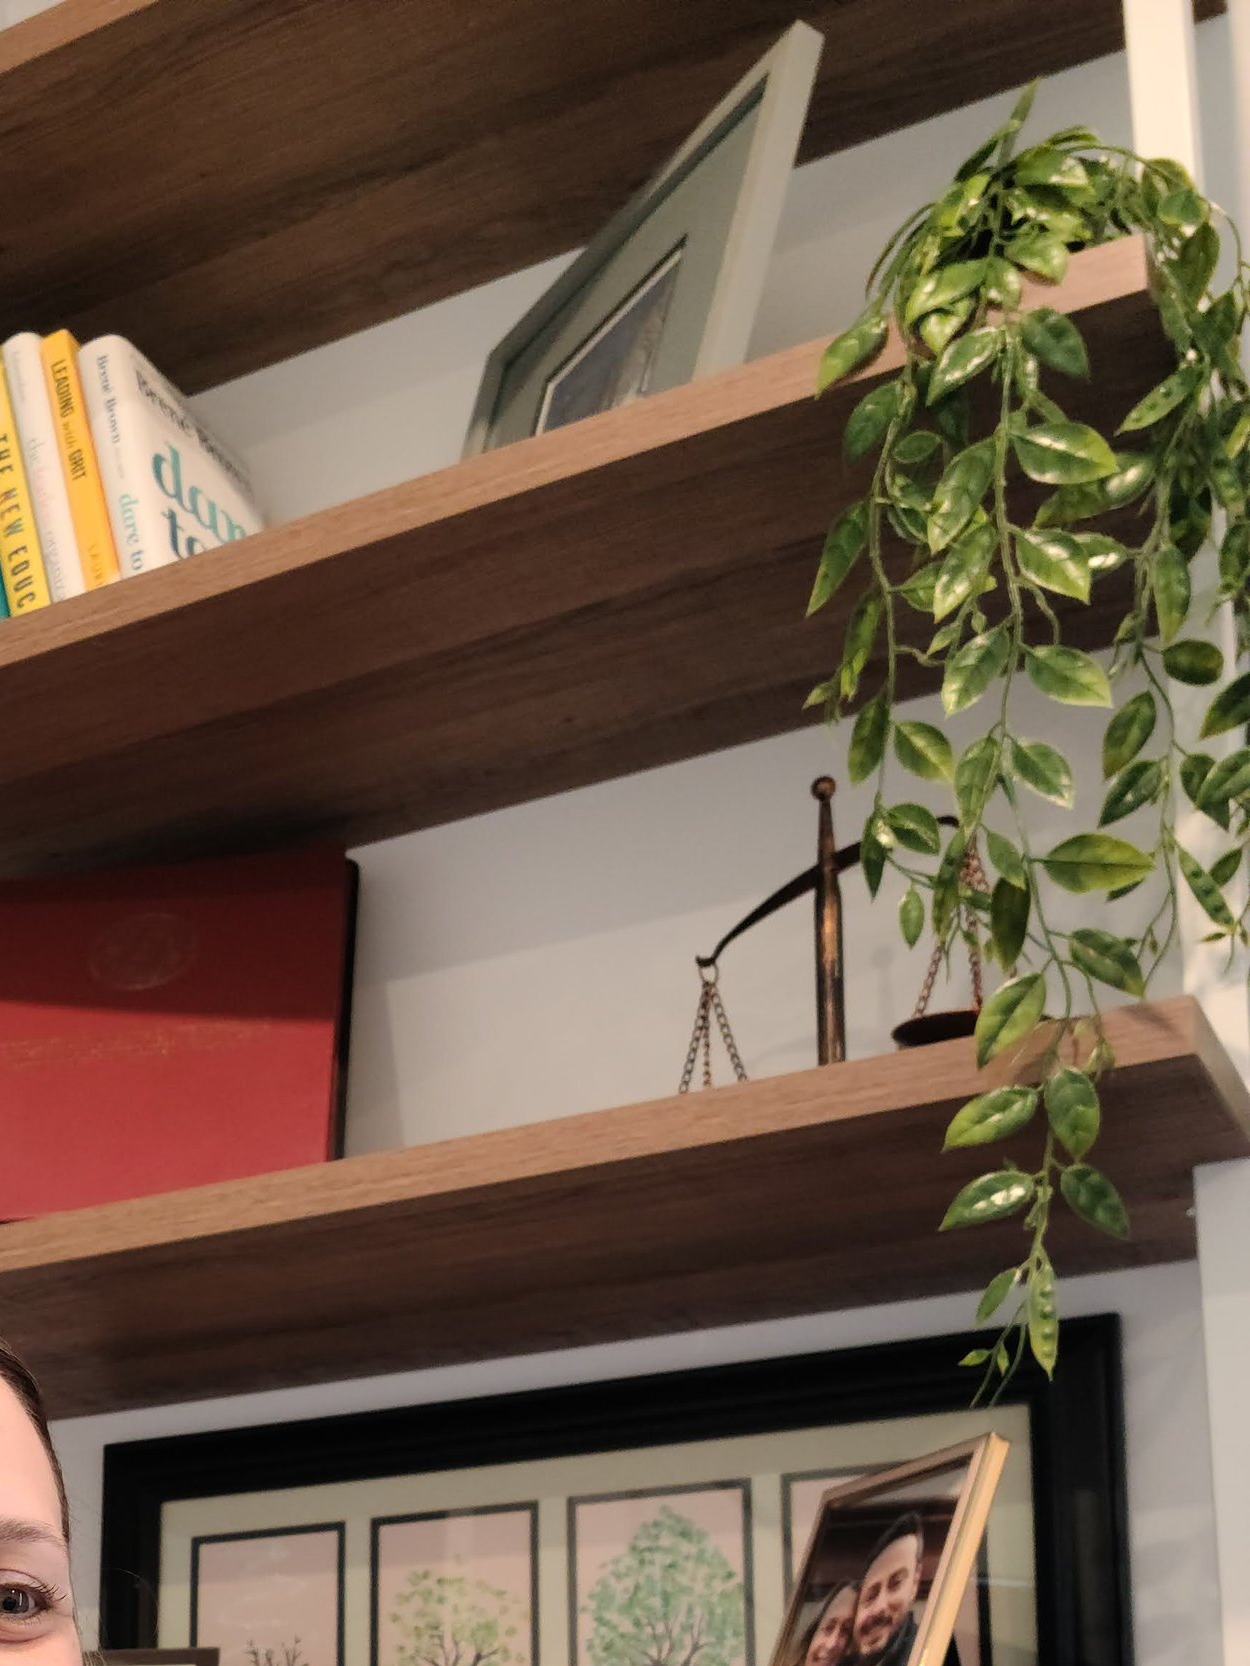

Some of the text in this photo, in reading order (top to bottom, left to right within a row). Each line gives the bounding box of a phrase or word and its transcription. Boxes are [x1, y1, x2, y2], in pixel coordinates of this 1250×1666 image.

[51, 358, 76, 419] LEADING
[68, 448, 87, 481] GRIT
[120, 493, 139, 545] dare
[130, 550, 144, 571] to
